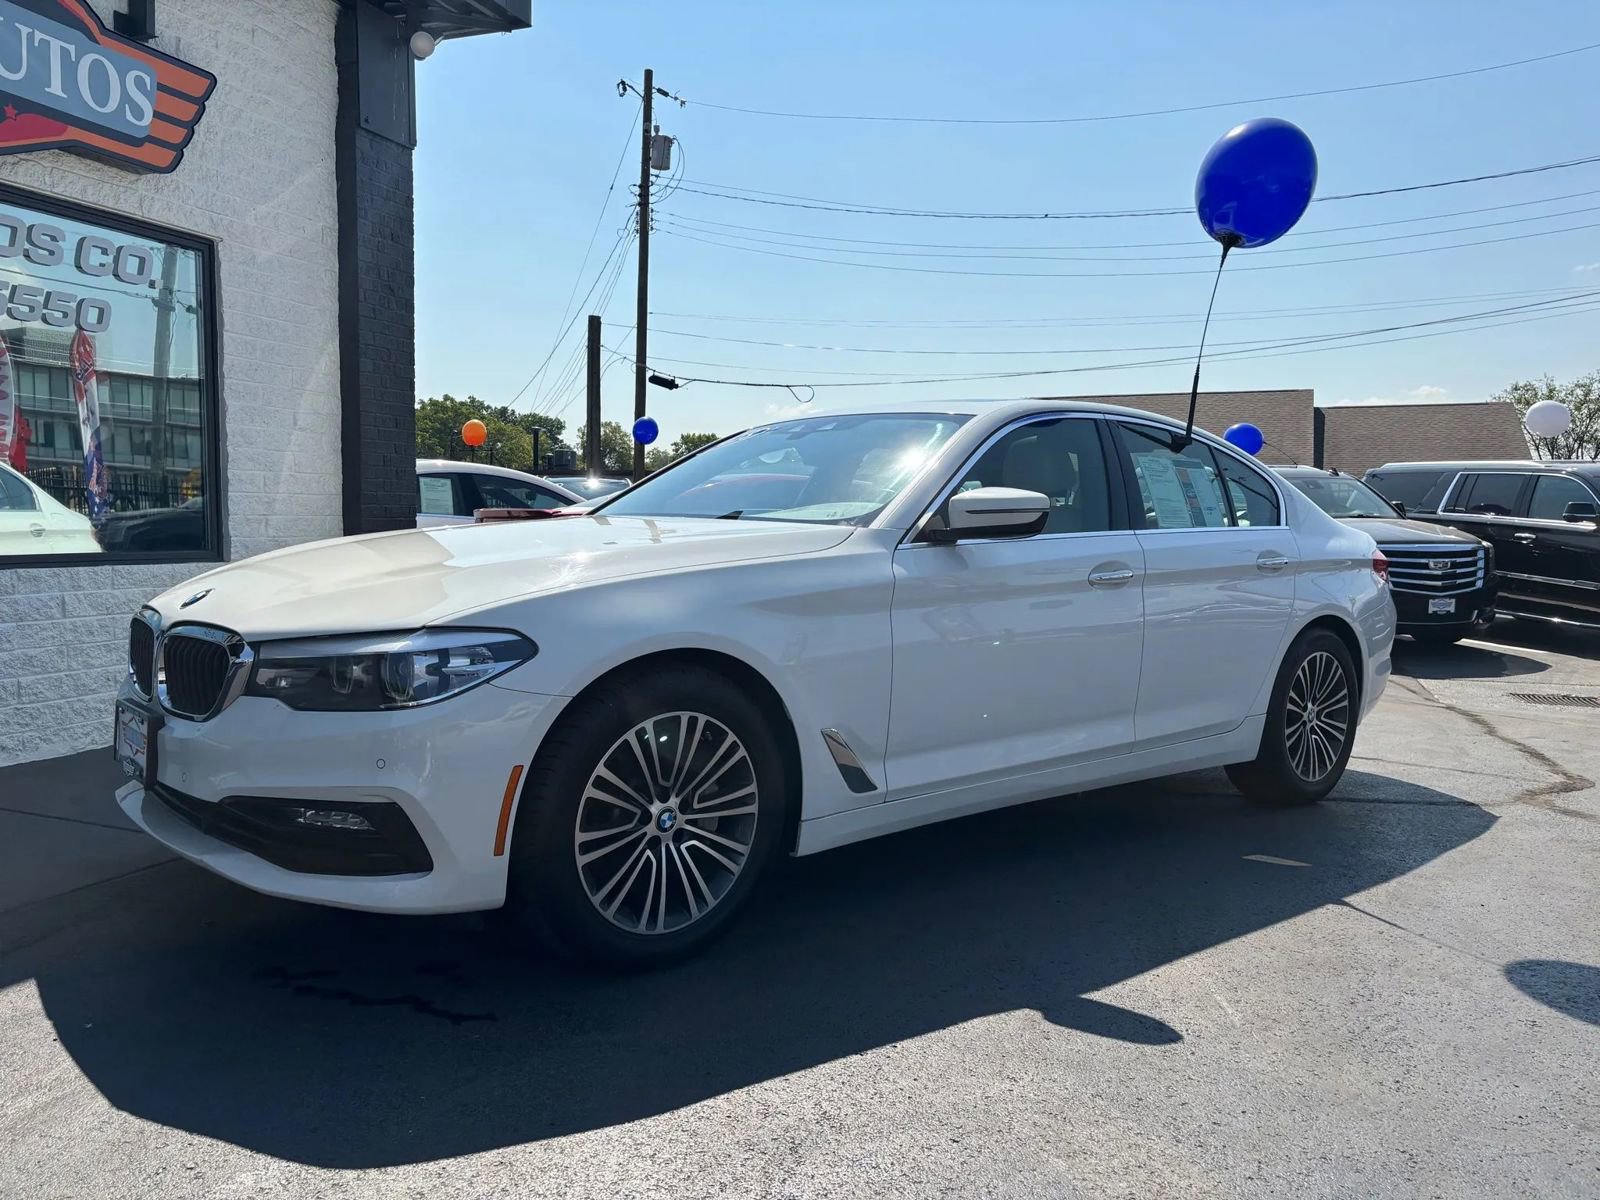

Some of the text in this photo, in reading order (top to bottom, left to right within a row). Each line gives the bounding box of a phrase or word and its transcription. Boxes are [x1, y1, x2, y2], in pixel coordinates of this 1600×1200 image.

[0, 20, 154, 127] UTOS
[74, 235, 164, 290] CO.
[0, 280, 112, 333] 550
